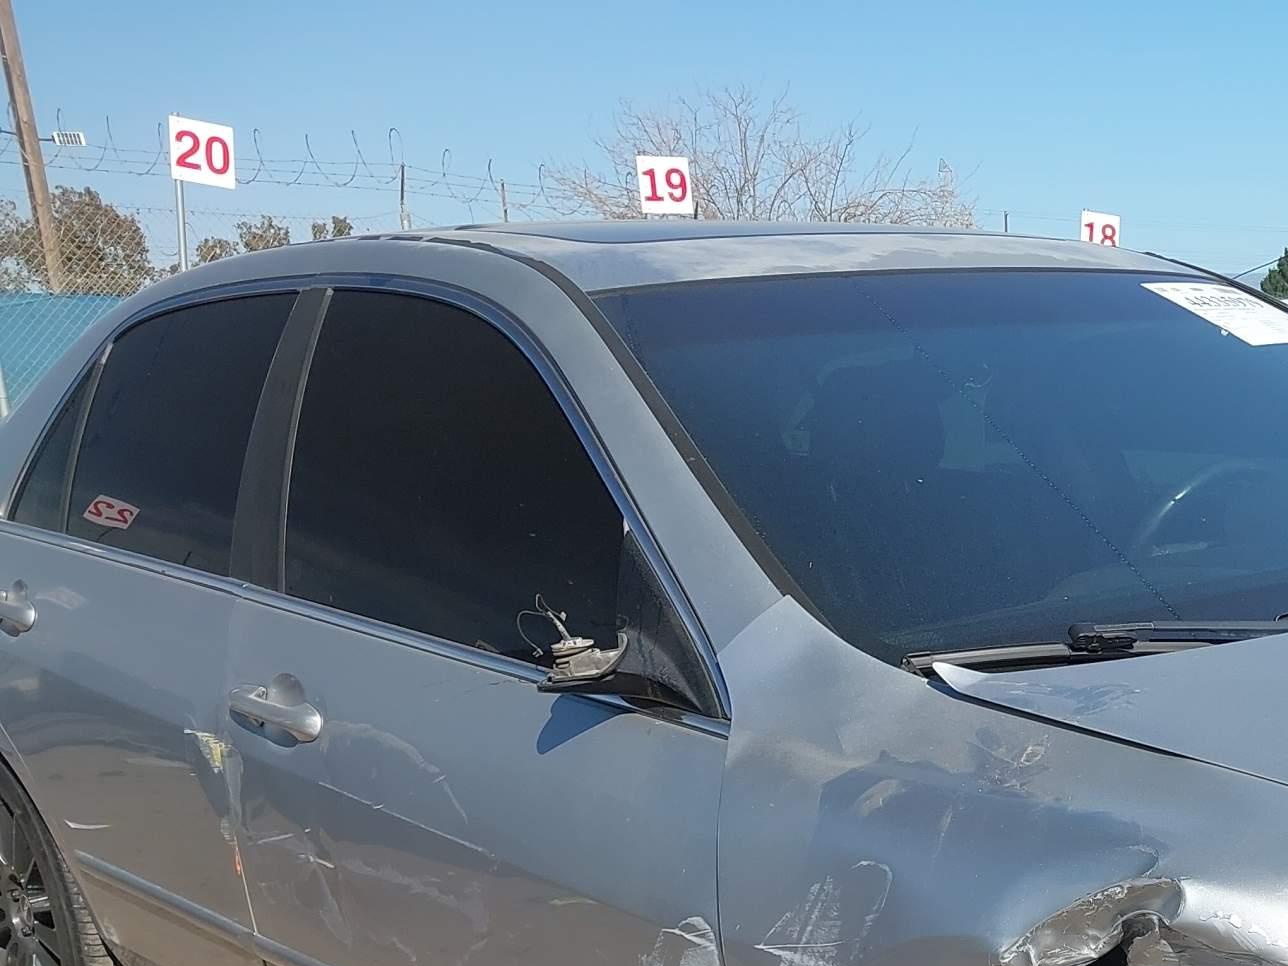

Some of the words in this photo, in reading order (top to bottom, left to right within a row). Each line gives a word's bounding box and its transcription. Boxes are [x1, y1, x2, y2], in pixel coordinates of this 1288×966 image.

[175, 129, 231, 175] 20
[641, 167, 688, 203] 19
[1083, 222, 1117, 248] 18
